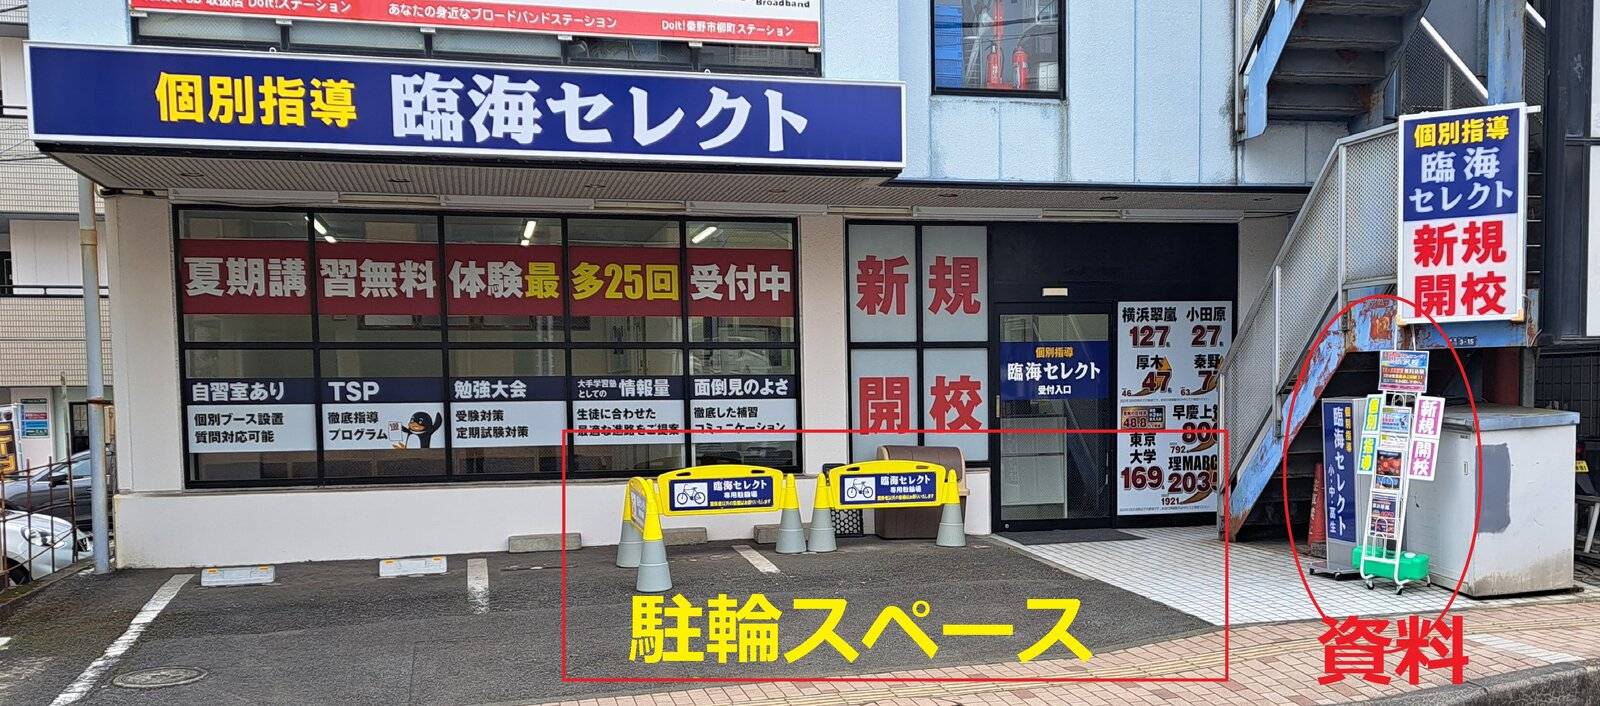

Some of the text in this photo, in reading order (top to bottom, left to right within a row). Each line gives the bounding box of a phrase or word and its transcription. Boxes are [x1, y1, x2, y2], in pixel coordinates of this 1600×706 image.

[388, 3, 617, 28] あなたの身近なブロードバンドステーション
[155, 71, 808, 153] 個別指導 臨海セレクト
[1413, 115, 1509, 148] 個別指導
[1420, 146, 1500, 184] 臨海
[1408, 181, 1513, 213] セレクト
[1413, 220, 1507, 268] 新規
[1413, 271, 1507, 319] 開校
[1186, 306, 1227, 322] 小田原
[1035, 346, 1074, 359] 個別指導
[1136, 354, 1164, 370] 厚木
[1007, 361, 1101, 382] 臨海セレクト
[192, 381, 285, 402] 自習室あり
[328, 381, 380, 401] TSP
[453, 378, 527, 400] 勉強大会
[577, 378, 617, 388] 大手学習塾
[578, 377, 671, 399] としての 情報量
[694, 377, 789, 397] 面倒見のよさ
[1037, 384, 1072, 395] 受付入口
[193, 412, 284, 427] 個別ブース設置
[327, 411, 379, 425] 徹底指導
[455, 409, 504, 422] 受験対策
[576, 407, 657, 421] 生徒に合わせた
[694, 406, 758, 419] 徹底した補習
[1418, 400, 1439, 435] 新規
[194, 430, 275, 444] 質問対応可能
[328, 428, 388, 442] プログラム
[455, 426, 529, 440] 定期試験対策
[1130, 430, 1157, 447] 東京
[1129, 449, 1157, 464] 大学
[1413, 441, 1433, 477] 開校
[1121, 465, 1165, 491] 169
[1333, 406, 1347, 536] 臨海セレクト
